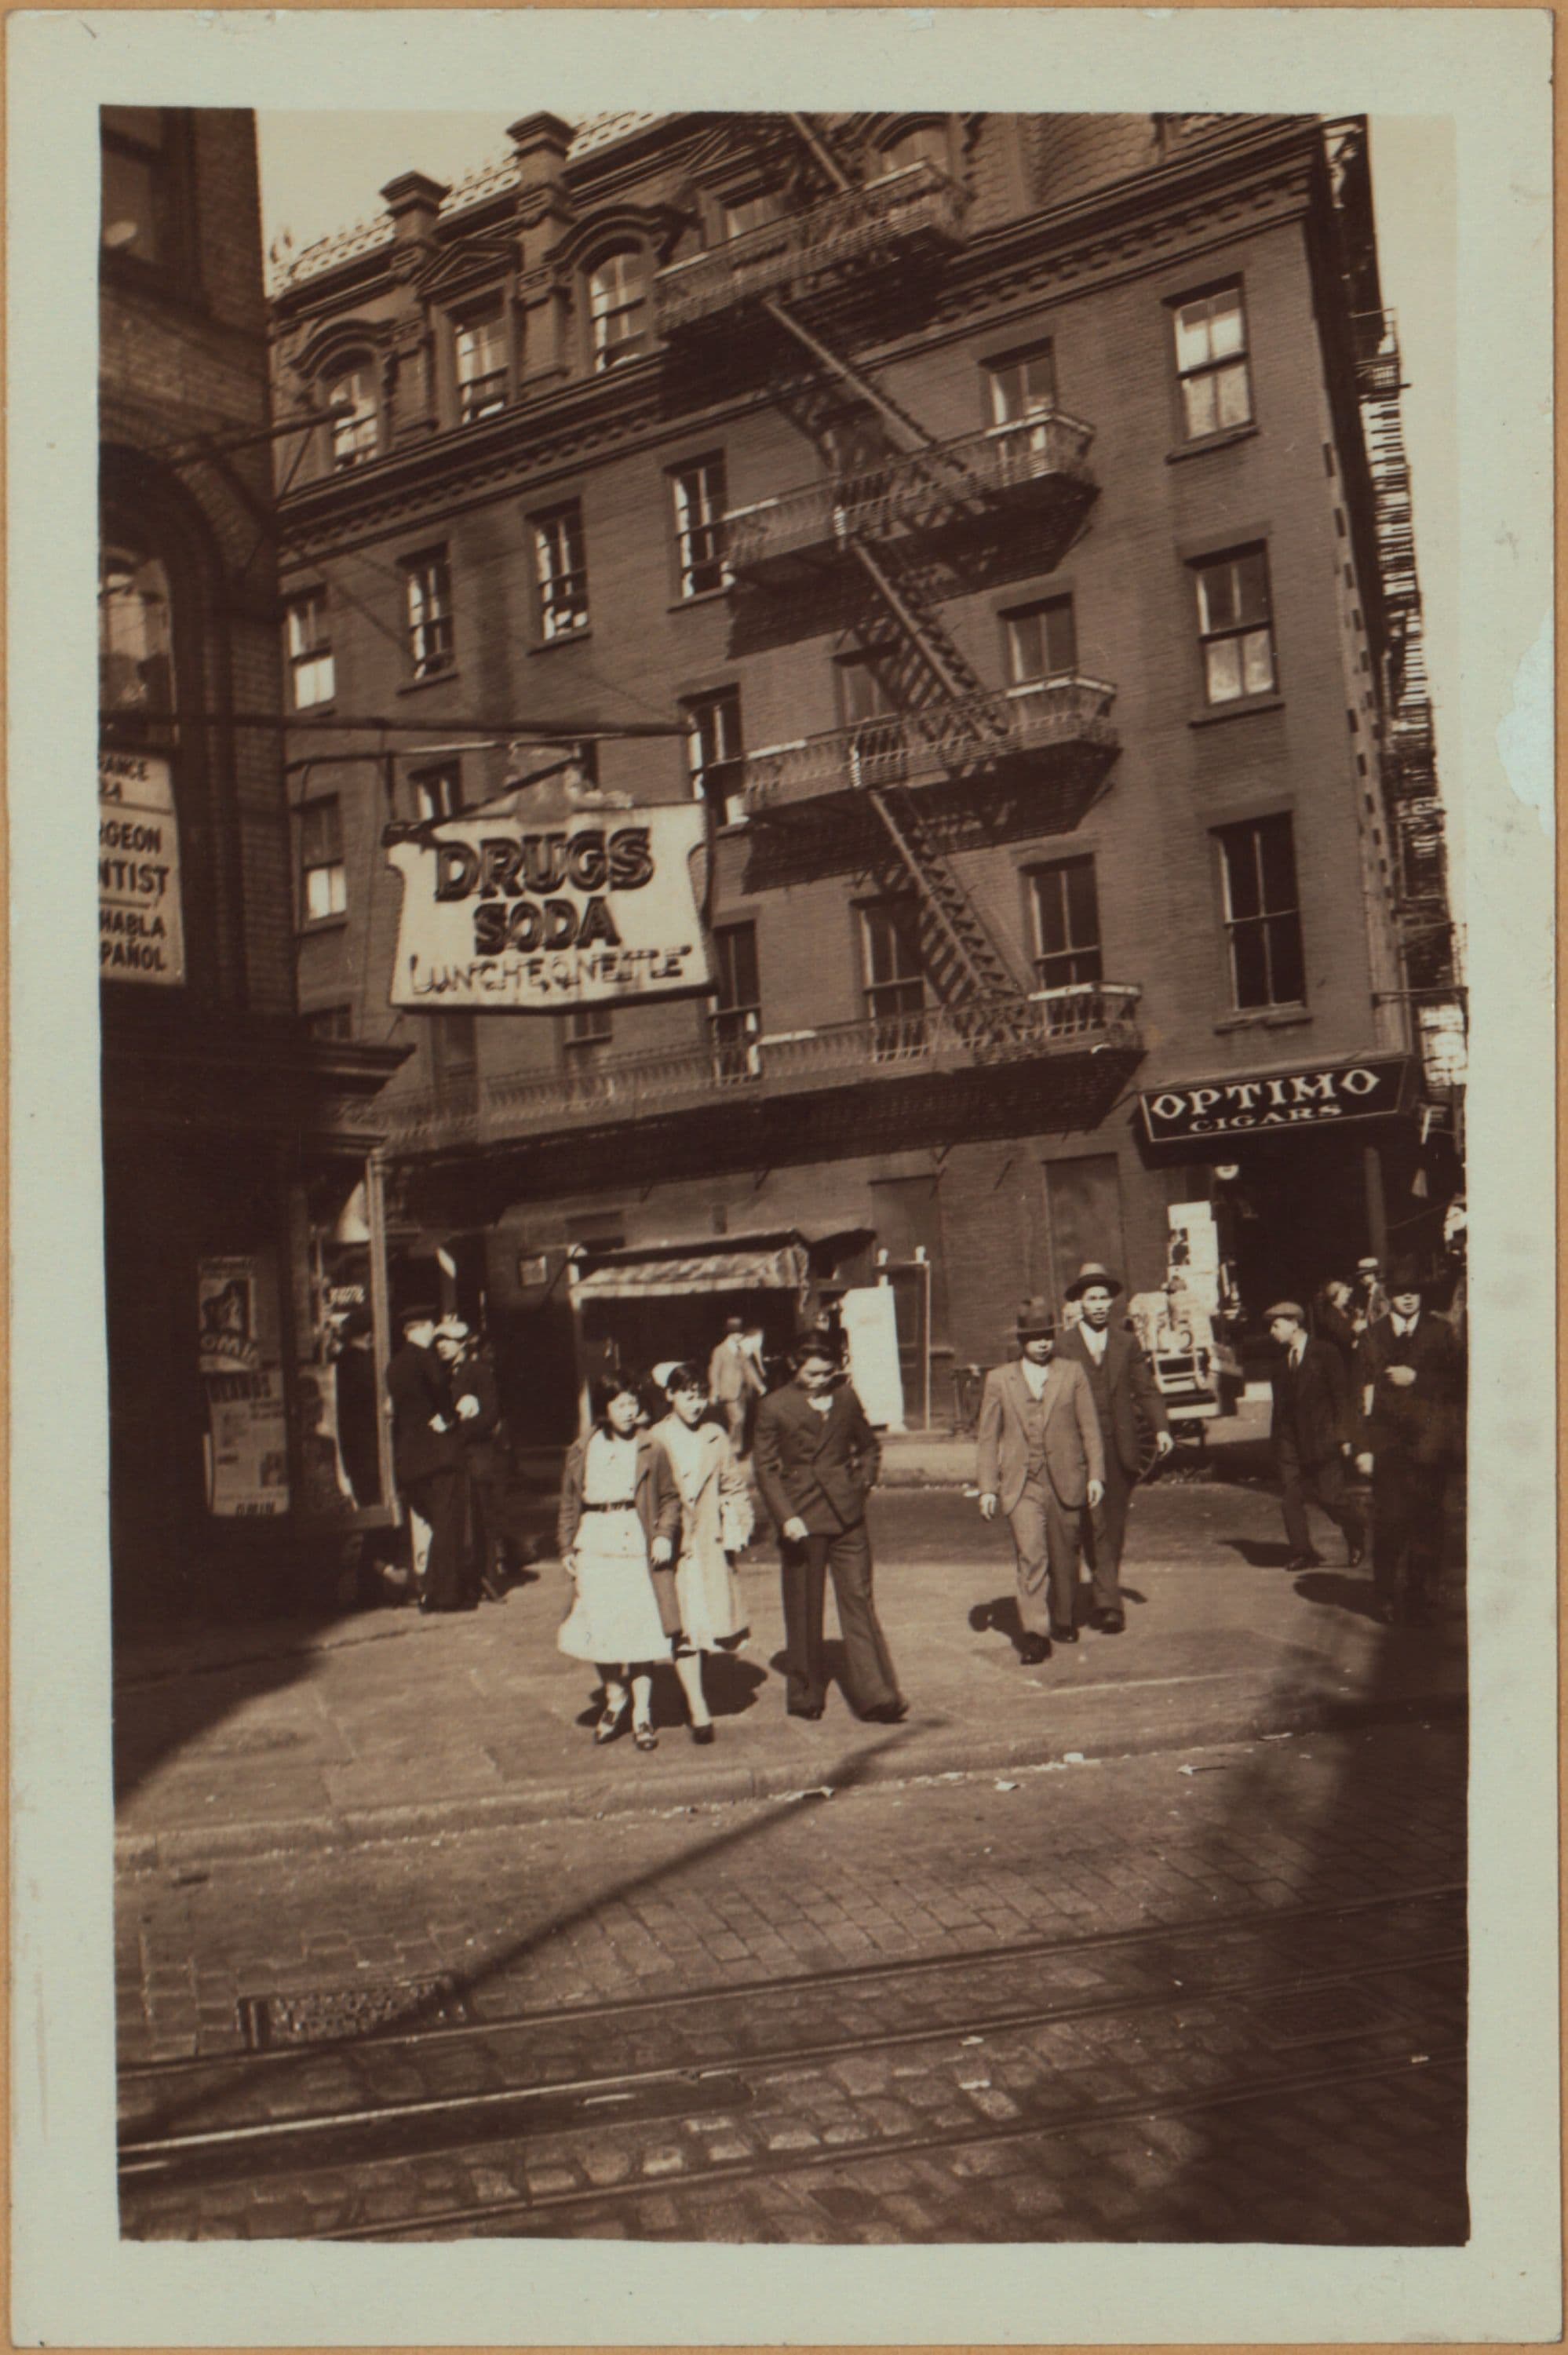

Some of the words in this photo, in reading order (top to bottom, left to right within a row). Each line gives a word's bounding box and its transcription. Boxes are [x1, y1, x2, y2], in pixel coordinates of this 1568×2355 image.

[100, 819, 162, 855] GEON
[434, 827, 655, 902] DRUGS
[473, 896, 622, 957] SODA
[409, 944, 694, 995] LUNCHEONETTE
[1150, 1068, 1380, 1119] OPTIMO
[1189, 1104, 1343, 1132] CIGARS
